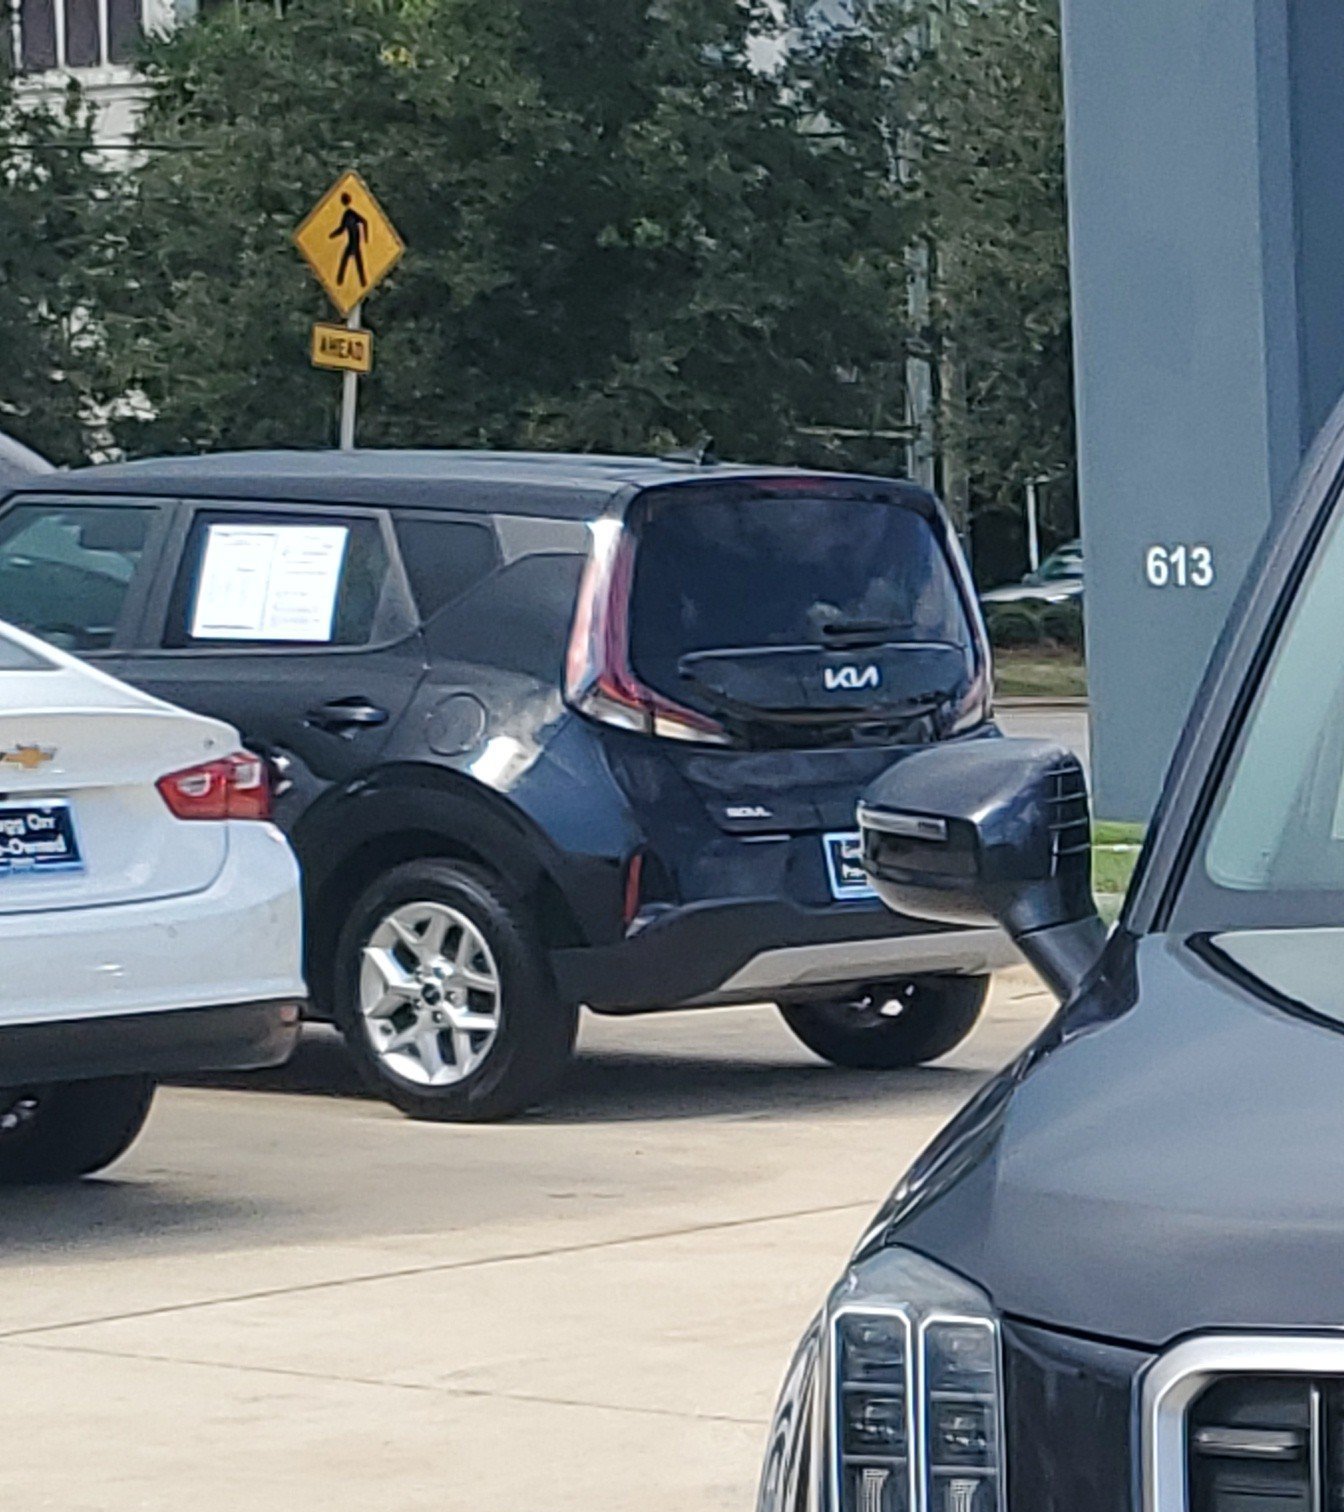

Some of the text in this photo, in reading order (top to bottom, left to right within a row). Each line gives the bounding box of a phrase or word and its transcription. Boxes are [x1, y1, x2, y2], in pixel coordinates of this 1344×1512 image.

[320, 336, 364, 361] AHEAD
[1146, 545, 1214, 587] 613
[824, 665, 879, 688] KIA
